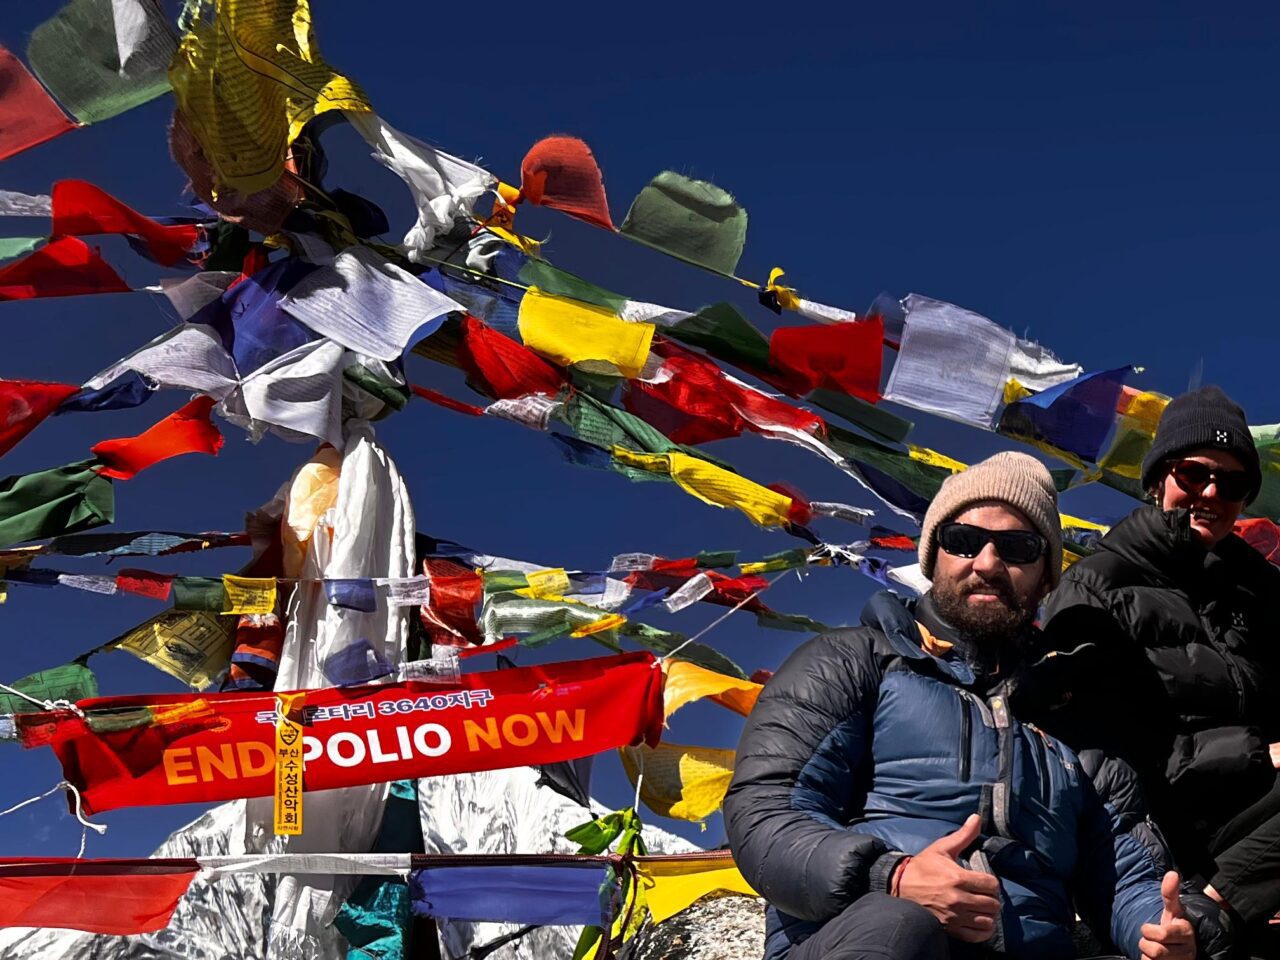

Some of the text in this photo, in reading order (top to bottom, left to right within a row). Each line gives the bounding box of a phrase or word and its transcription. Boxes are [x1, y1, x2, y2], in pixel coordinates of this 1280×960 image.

[255, 689, 494, 727] 국로타리 3640지구
[164, 708, 587, 786] END POLIO NOW
[278, 748, 299, 758] 부산
[284, 760, 298, 825] 수성산악회
